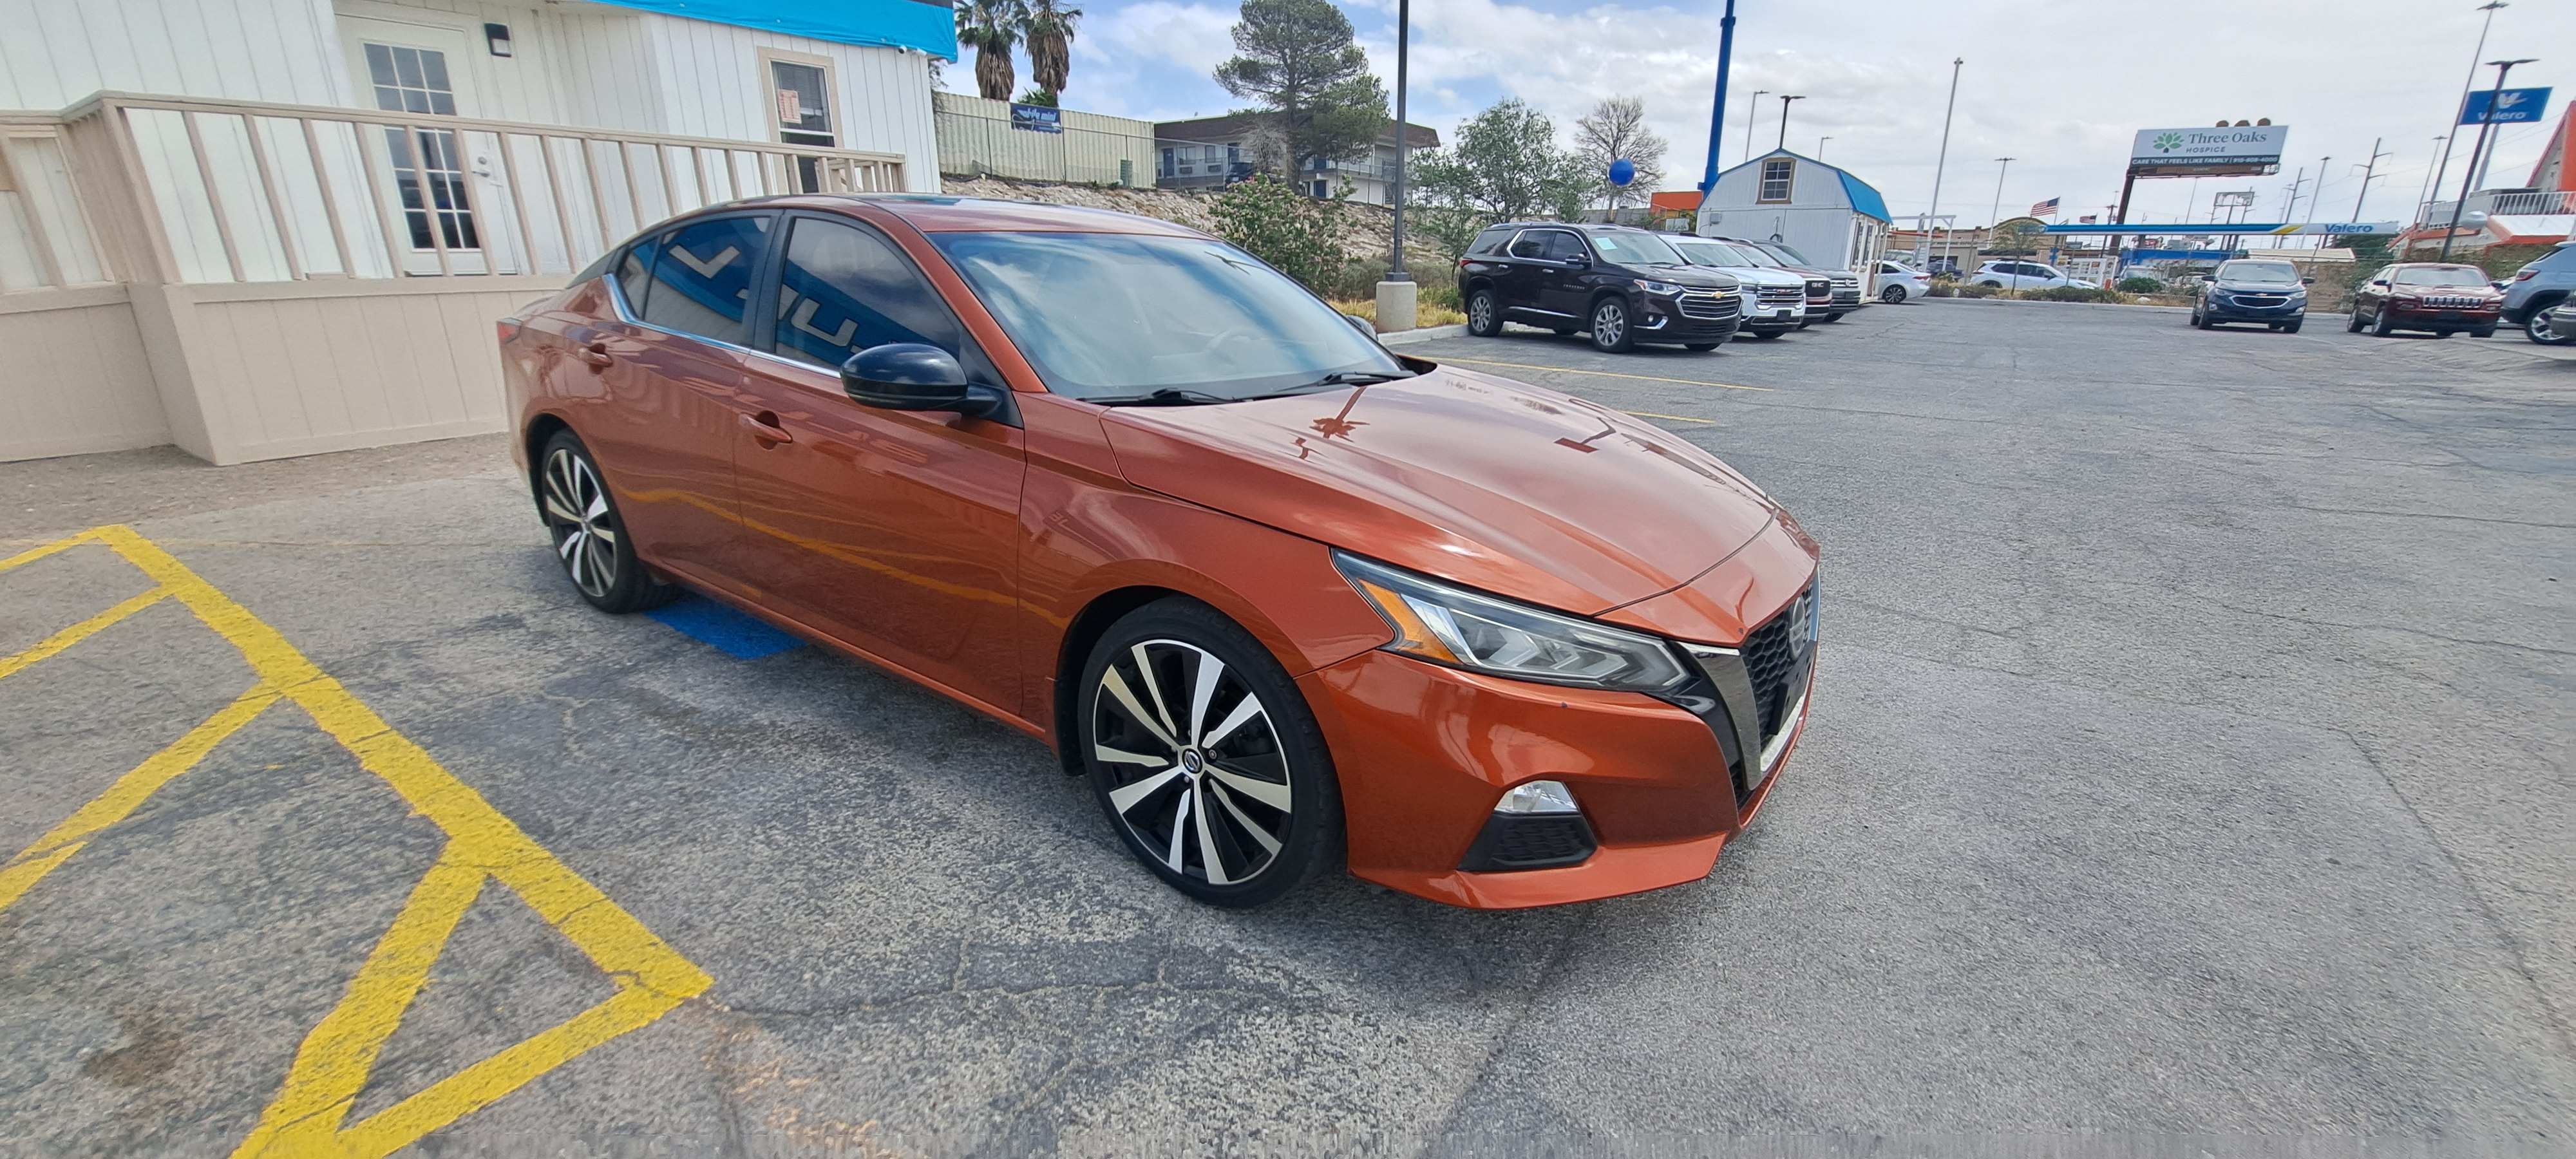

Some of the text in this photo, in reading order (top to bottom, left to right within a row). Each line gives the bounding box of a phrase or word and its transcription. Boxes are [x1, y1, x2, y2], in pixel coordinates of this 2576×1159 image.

[2477, 111, 2527, 120] Vlero
[2188, 131, 2267, 144] Three Oaks
[2325, 223, 2373, 232] Valero
